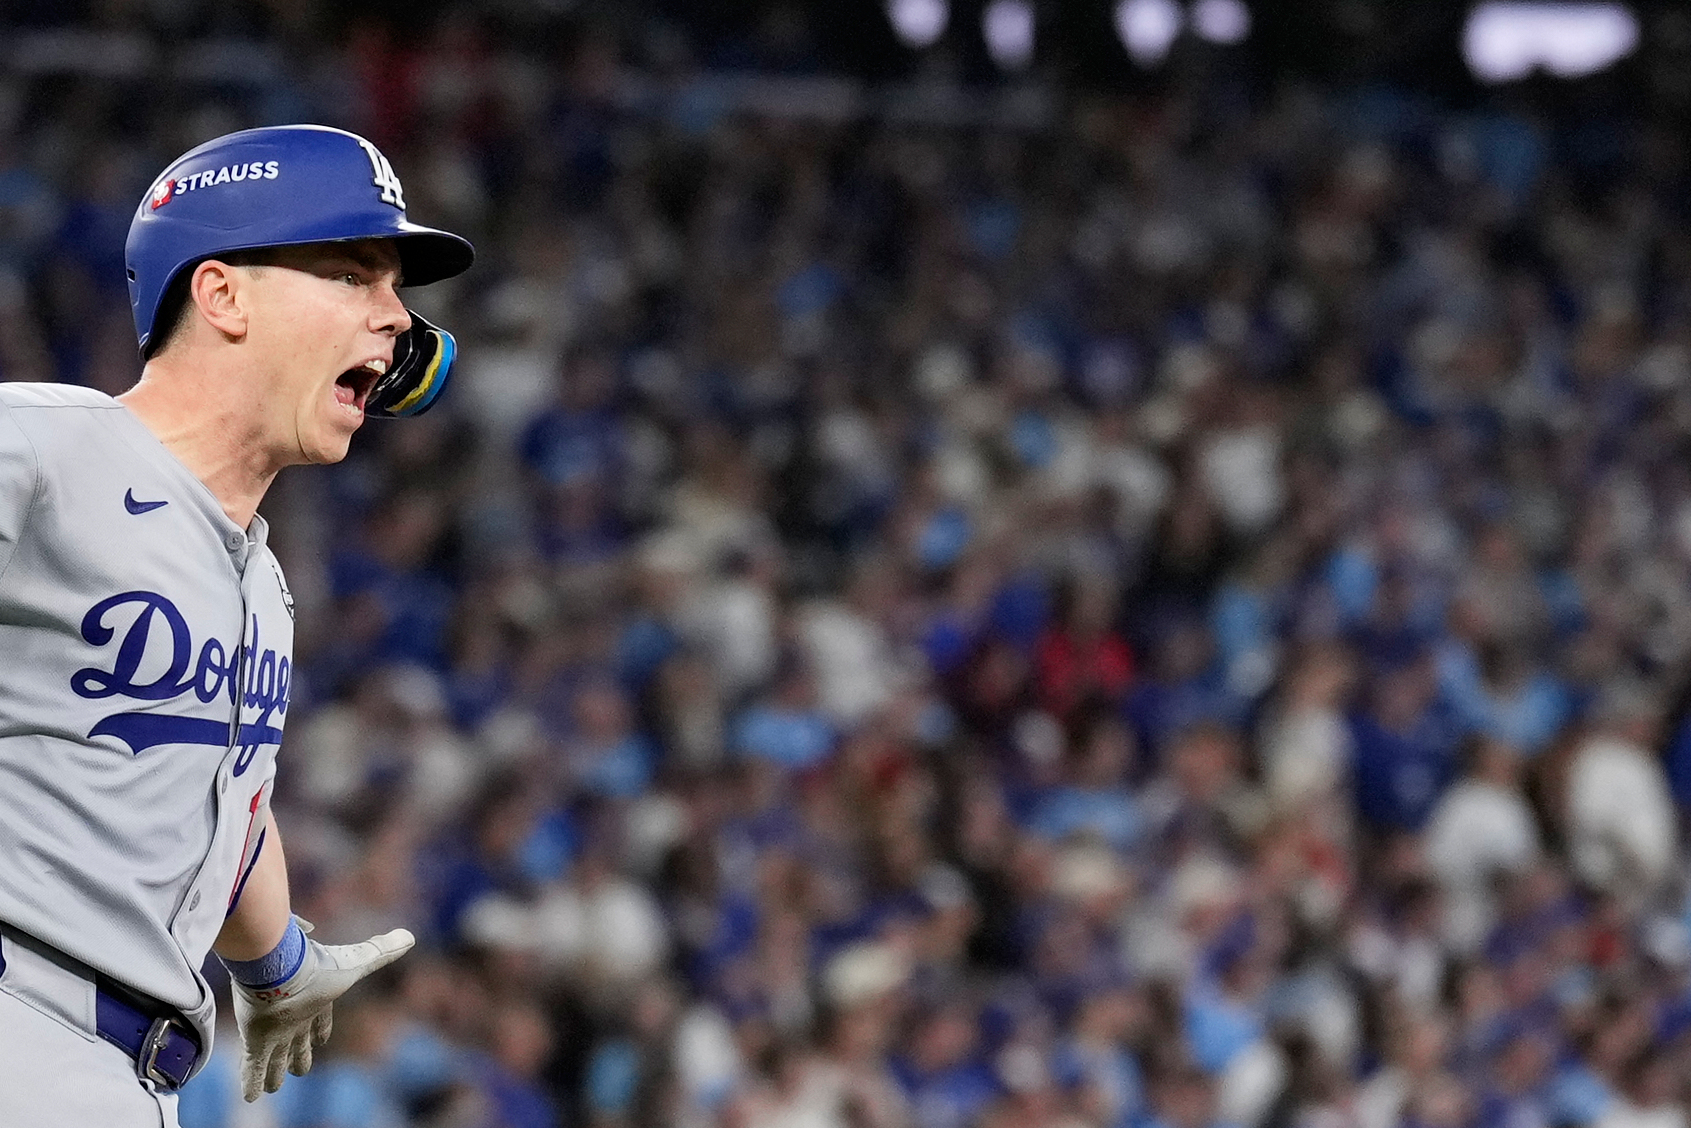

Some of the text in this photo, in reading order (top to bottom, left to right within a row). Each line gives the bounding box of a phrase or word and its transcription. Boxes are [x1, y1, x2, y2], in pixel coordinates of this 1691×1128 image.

[174, 160, 279, 195] STRAUSS
[359, 140, 406, 209] LA
[71, 591, 292, 778] Dodge
